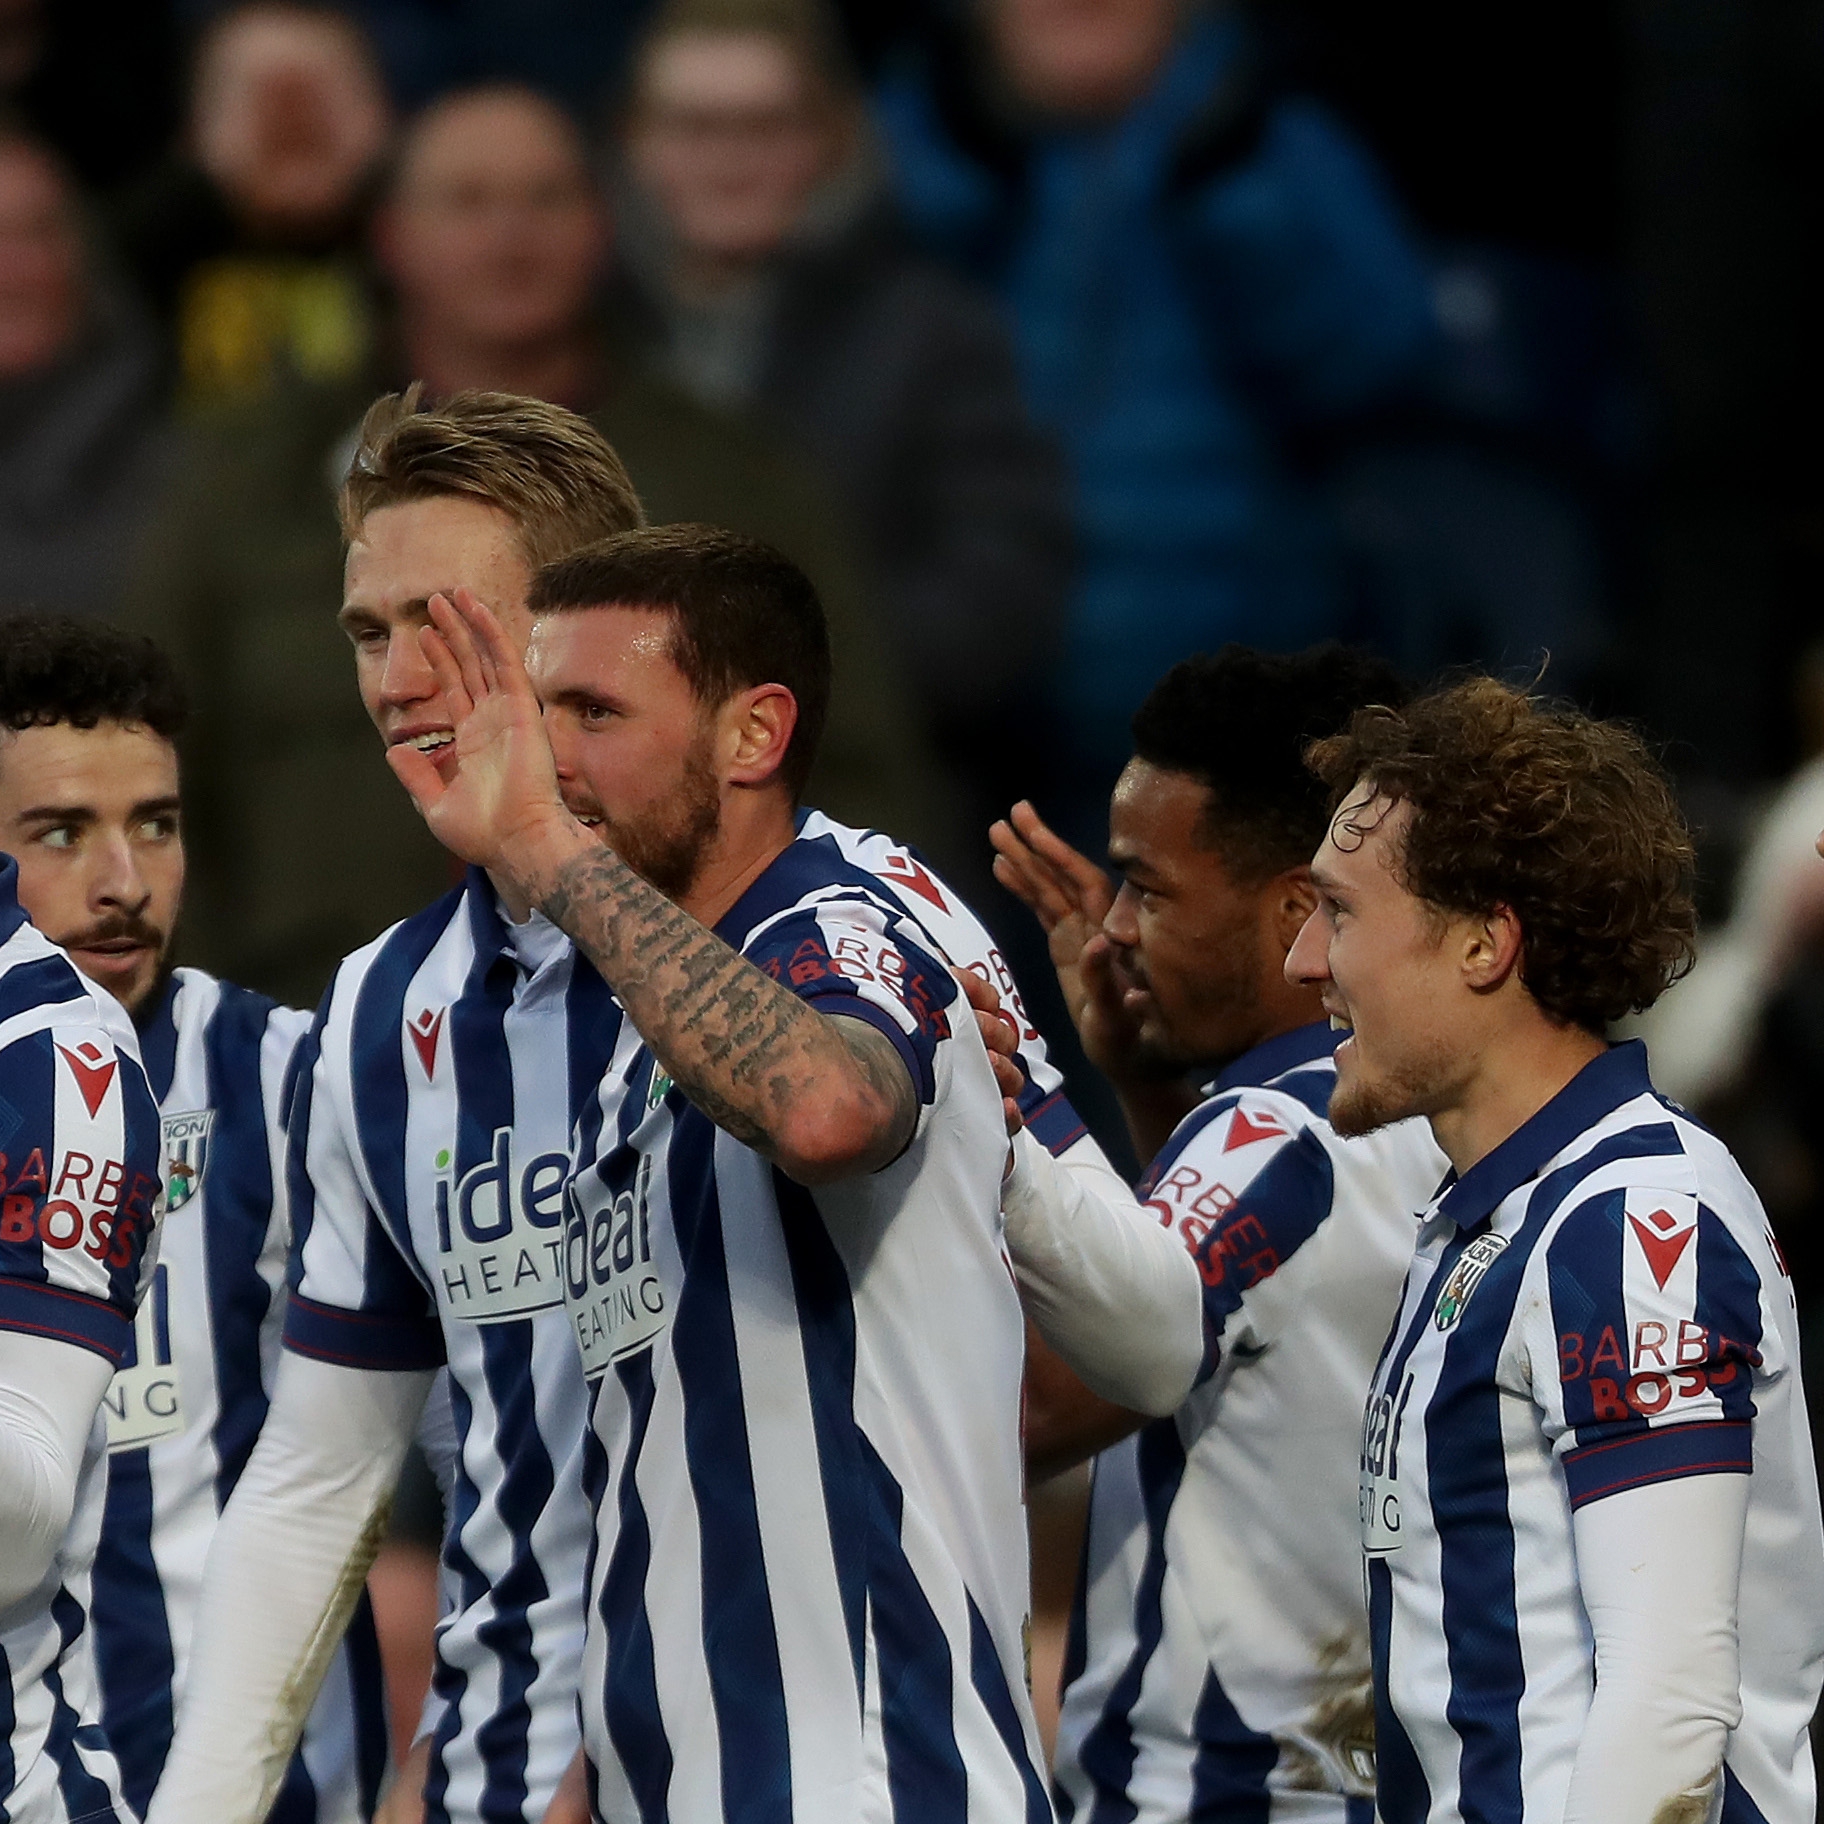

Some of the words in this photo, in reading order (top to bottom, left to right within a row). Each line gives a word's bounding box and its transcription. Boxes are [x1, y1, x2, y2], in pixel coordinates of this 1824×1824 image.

[433, 1131, 572, 1253] ide
[564, 1153, 653, 1300] deal
[442, 1240, 563, 1304] HEAT
[576, 1276, 665, 1351] EATING
